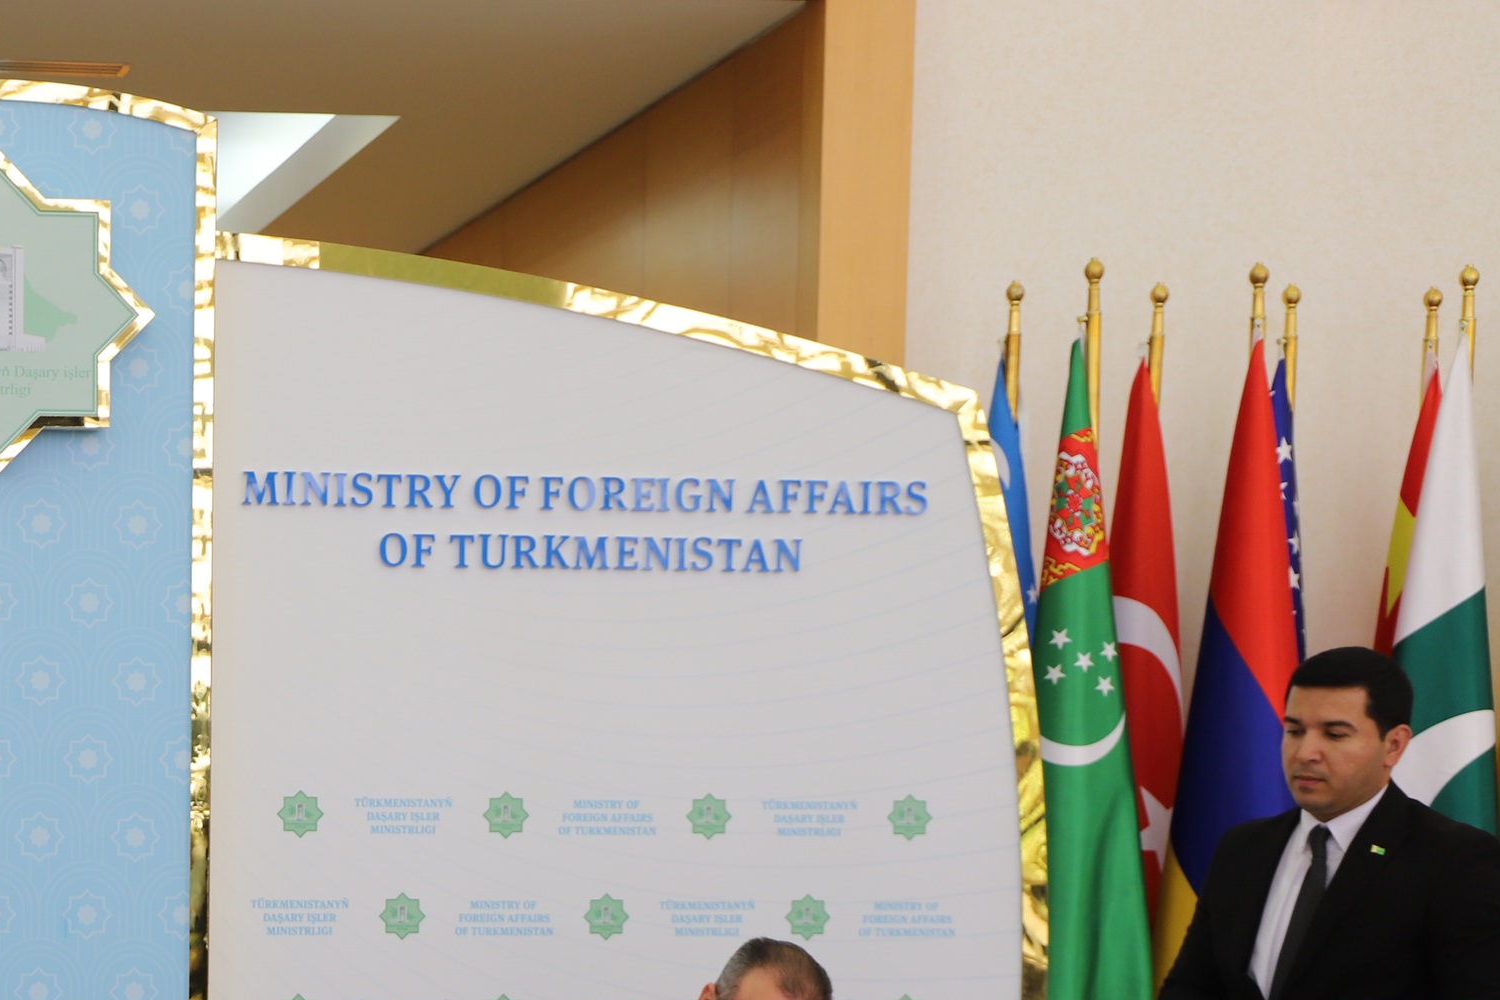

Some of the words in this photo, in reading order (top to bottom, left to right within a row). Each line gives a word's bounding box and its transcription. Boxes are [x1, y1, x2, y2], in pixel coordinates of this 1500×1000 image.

[14, 365, 60, 381] Daşary
[64, 366, 92, 381] işler
[243, 471, 461, 508] MINISTRY
[474, 474, 530, 510] OF
[541, 476, 736, 514] FOREIGN
[745, 479, 929, 516] AFFAIRS
[380, 532, 436, 568] OF
[449, 534, 803, 573] TURKMENISTAN
[367, 812, 406, 822] DAŞARY
[412, 812, 441, 823] IŞLER
[370, 825, 436, 834] MINISTRLIGI
[470, 900, 520, 909] MINISTRY
[524, 900, 537, 909] OF
[262, 913, 303, 924] DAŞARY
[308, 913, 337, 924] IŞLER
[459, 913, 505, 923] FOREIGN
[508, 914, 551, 923] AFFAIRS
[266, 926, 333, 936] MINISTRLIGI
[455, 927, 469, 936] OF
[471, 926, 555, 936] TURKMENISTAN
